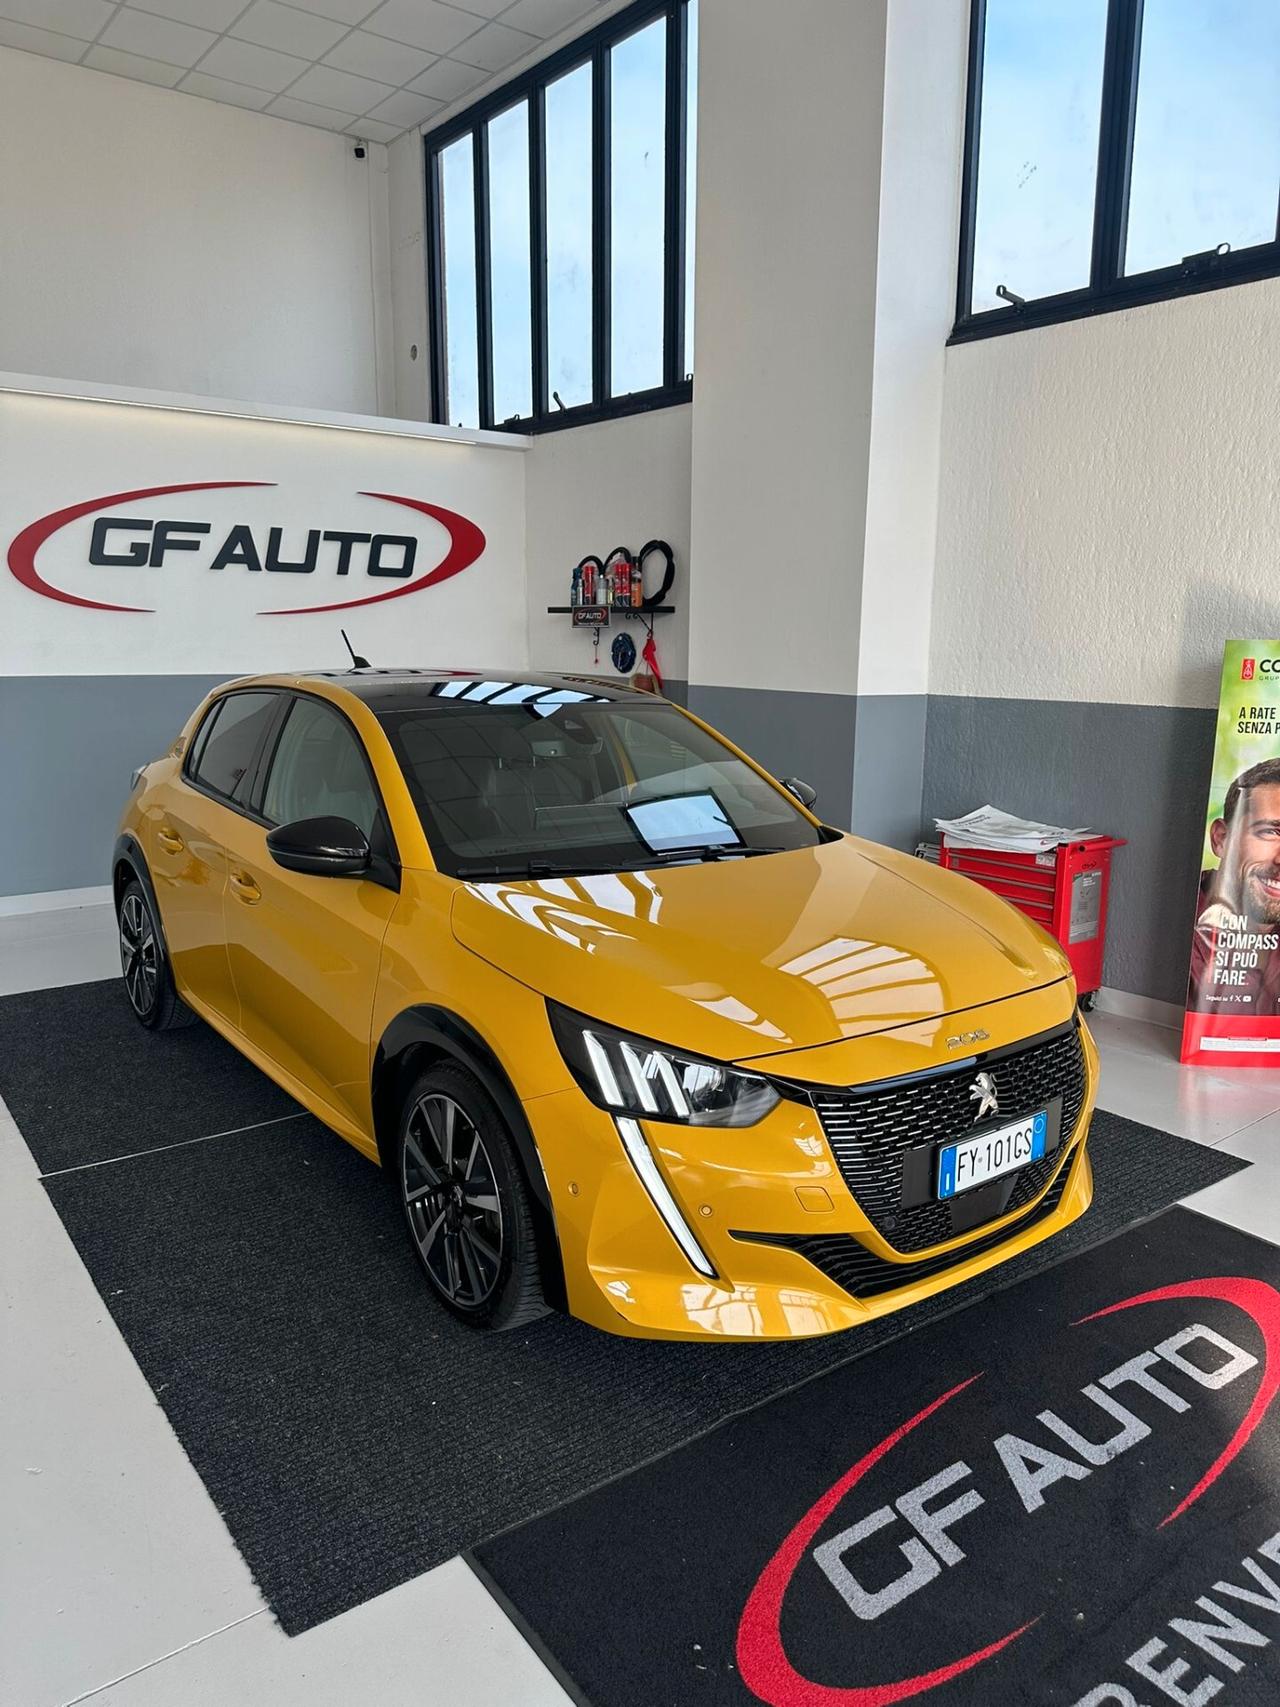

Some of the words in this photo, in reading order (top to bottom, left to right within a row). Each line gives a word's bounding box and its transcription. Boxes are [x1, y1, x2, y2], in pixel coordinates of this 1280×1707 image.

[89, 517, 211, 567] GF
[210, 524, 418, 578] AUTO
[1239, 707, 1246, 719] A
[1250, 707, 1277, 720] RATE
[1238, 721, 1272, 734] SENZA
[1221, 914, 1248, 930] CON
[1218, 932, 1279, 950] COMPASS
[1216, 951, 1229, 966] SI
[1232, 950, 1258, 968] PUÒ
[945, 1029, 990, 1049] 208
[813, 1460, 986, 1620] GF
[993, 1323, 1258, 1513] AUTO
